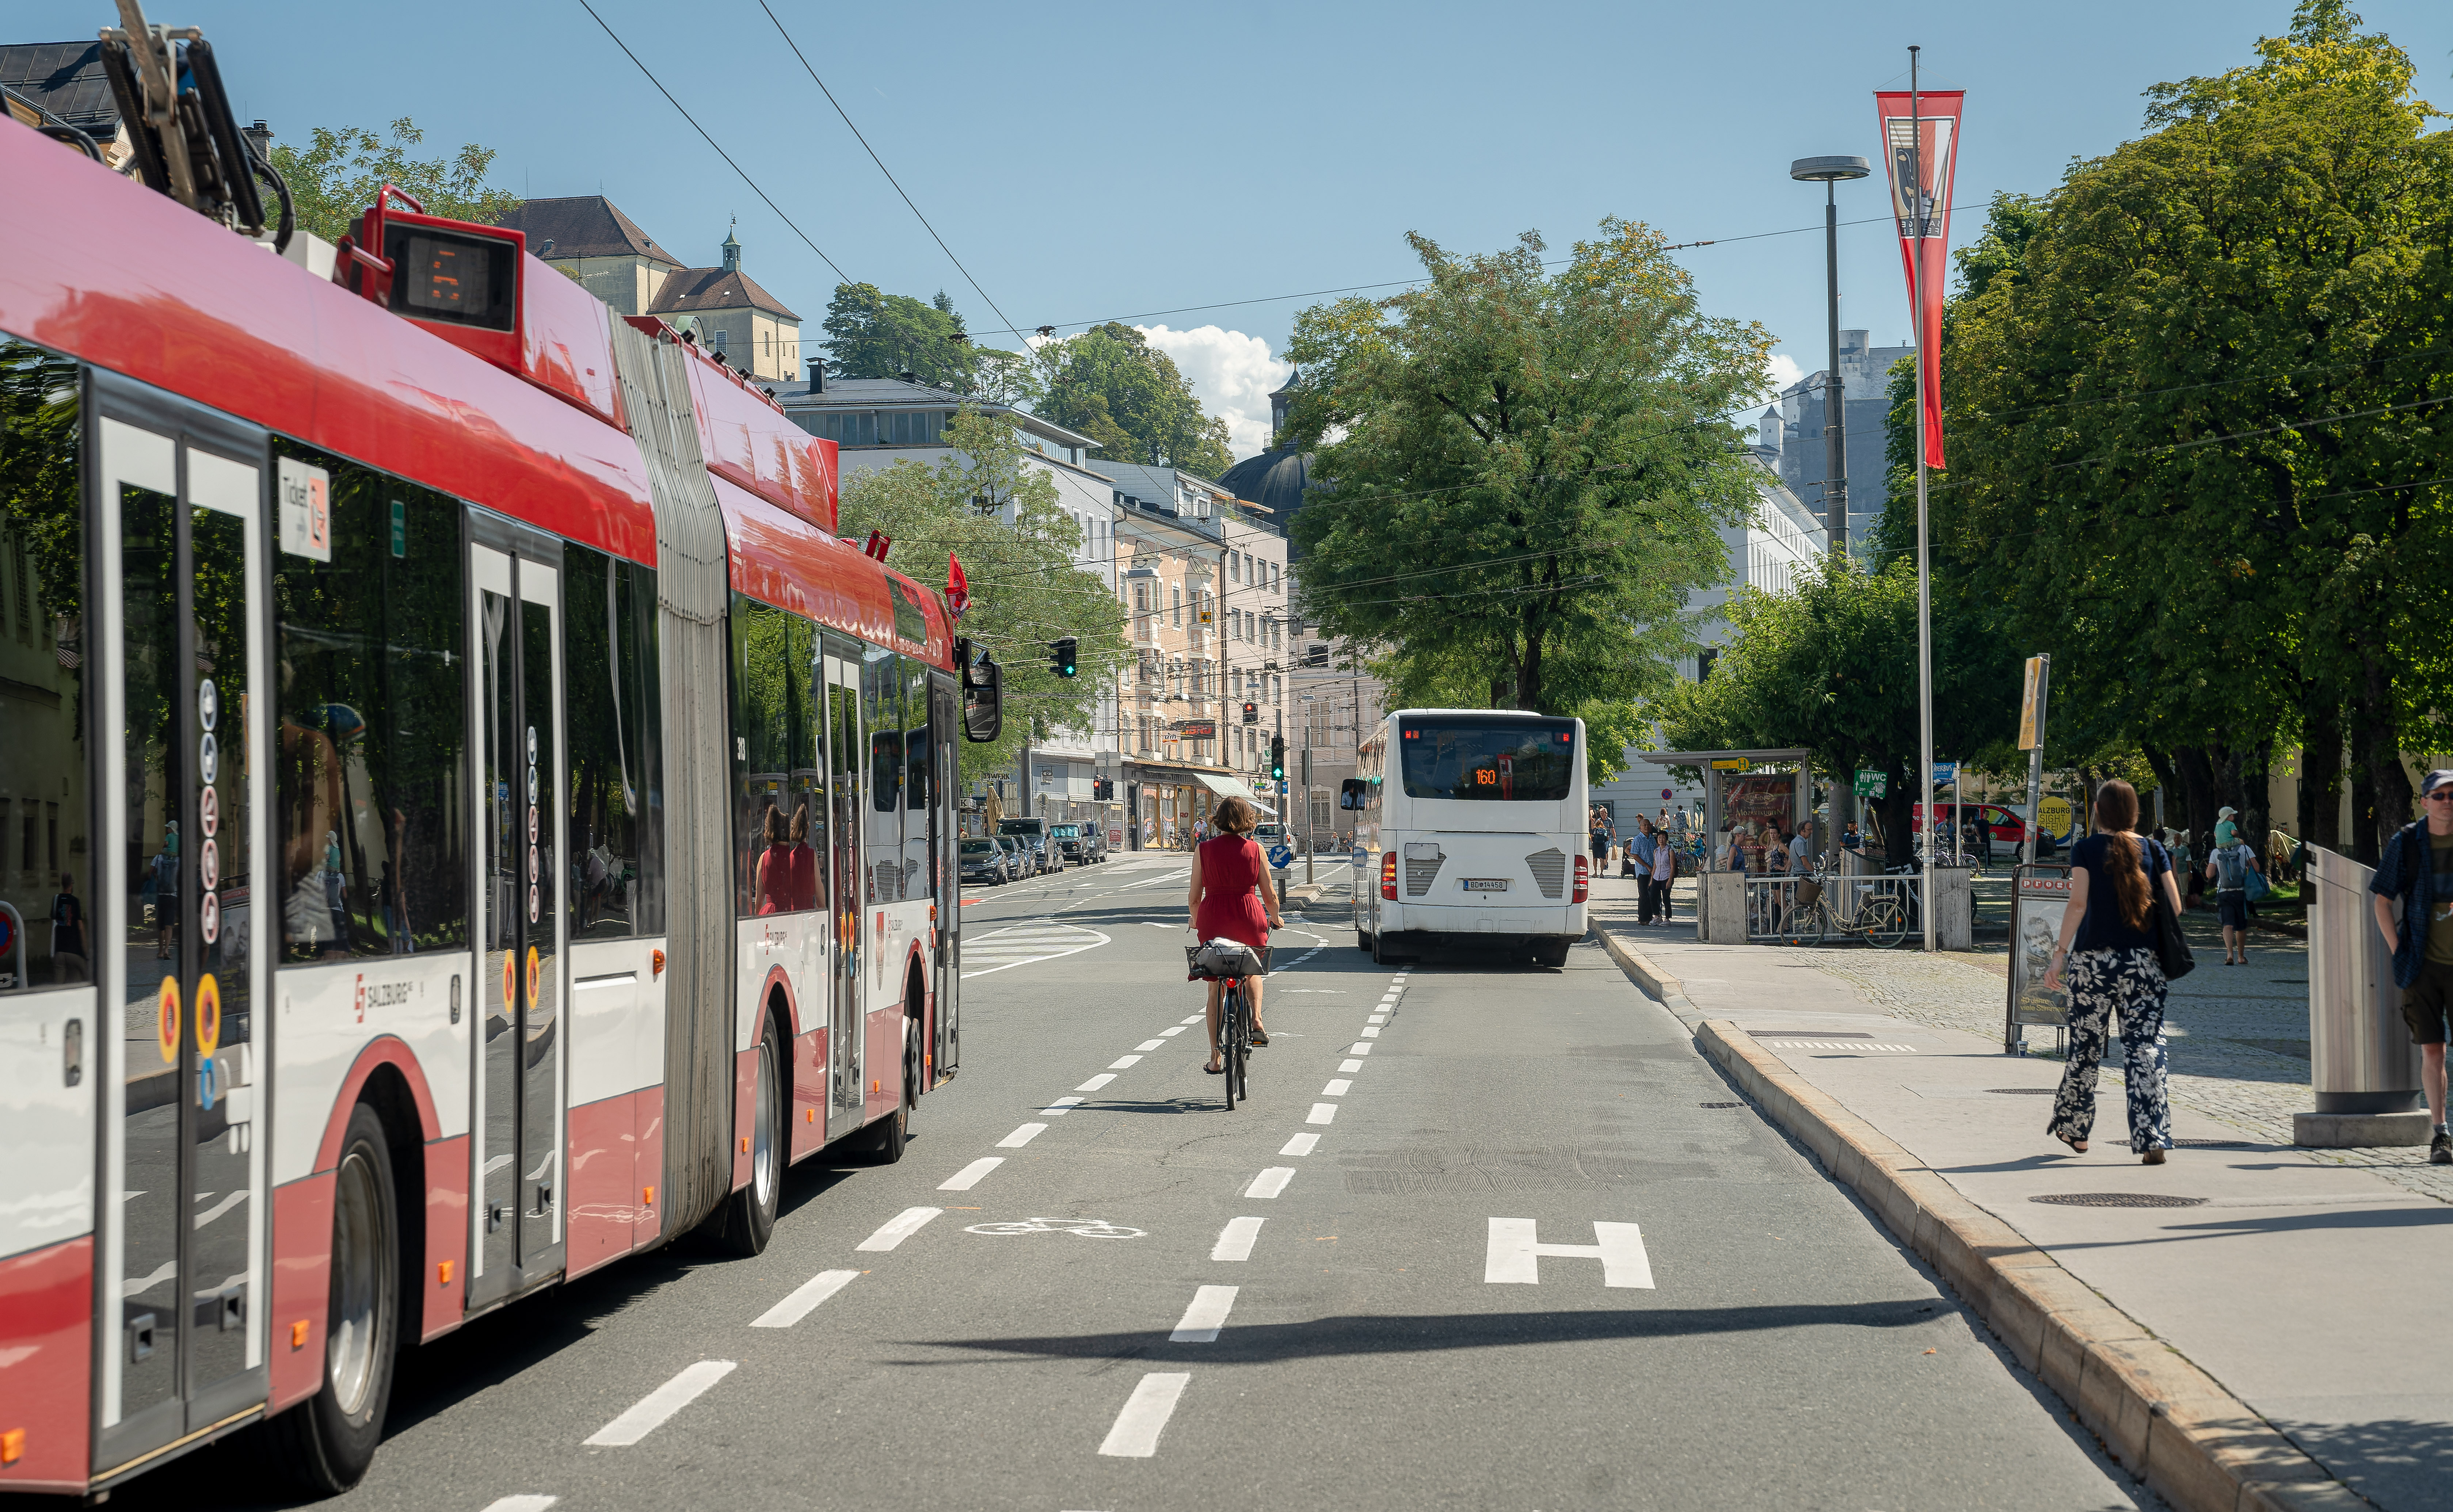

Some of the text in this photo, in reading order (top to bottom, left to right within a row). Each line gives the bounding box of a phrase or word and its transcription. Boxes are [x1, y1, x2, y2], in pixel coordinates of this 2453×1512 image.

[283, 476, 308, 507] Ticket
[738, 736, 746, 761] 313
[1738, 759, 1746, 769] H
[1932, 763, 1952, 772] HERBUS
[1476, 769, 1496, 784] 160
[1871, 773, 1886, 781] WC
[2039, 814, 2066, 822] SIGHT
[2039, 822, 2071, 831] SEEING
[367, 982, 407, 1008] SALZBURG
[2035, 1004, 2066, 1012] Stimmen
[1484, 1217, 1656, 1290] H
